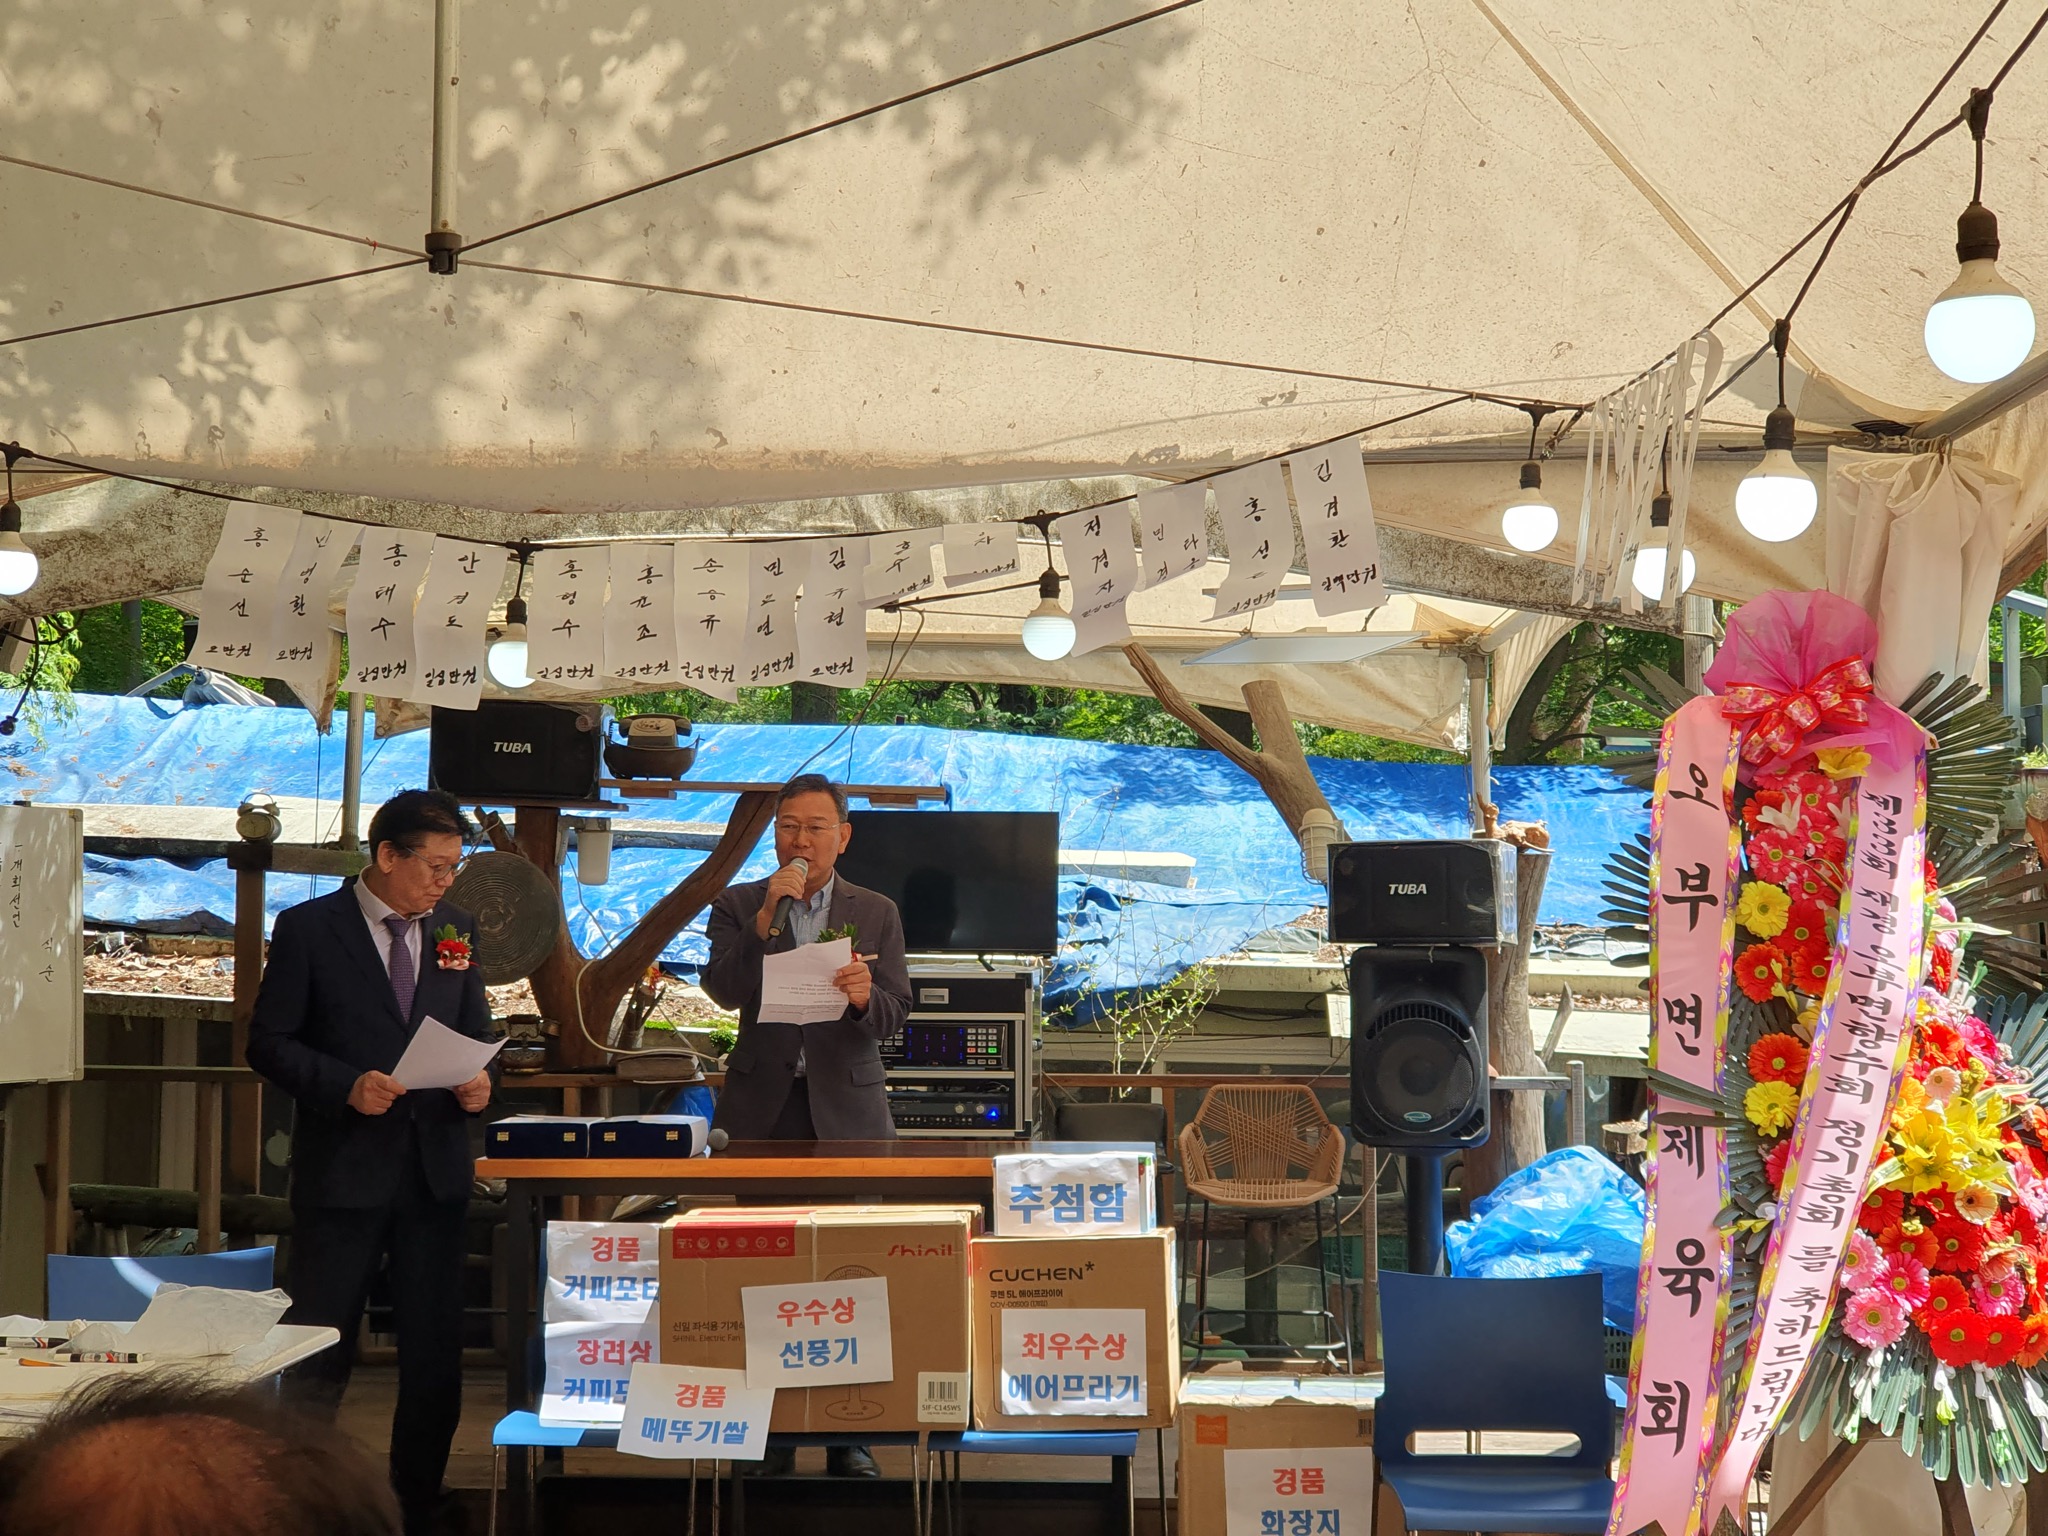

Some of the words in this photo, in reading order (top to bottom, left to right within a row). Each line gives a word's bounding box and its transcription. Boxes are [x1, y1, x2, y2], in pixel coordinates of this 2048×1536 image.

[493, 741, 532, 754] TUBA
[1388, 883, 1428, 895] TUBA
[1796, 1117, 1866, 1231] 정기총회
[1009, 1183, 1128, 1224] 추첨함
[591, 1236, 641, 1263] 경품
[1788, 1245, 1838, 1273] 를
[1018, 1288, 1064, 1298] 에어프라이어
[776, 1296, 856, 1328] 우수상
[727, 1333, 741, 1342] Fan
[1022, 1332, 1127, 1361] 최우수상
[576, 1339, 653, 1366] 장려상
[779, 1336, 859, 1369] 선풍기
[1741, 1286, 1827, 1442] 축하드립니다
[674, 1383, 727, 1409] 경품
[1008, 1374, 1140, 1402] 에어프라기
[641, 1417, 750, 1445] 메뚜기쌀
[1272, 1467, 1326, 1496] 경품
[1260, 1508, 1341, 1536] 화장지
